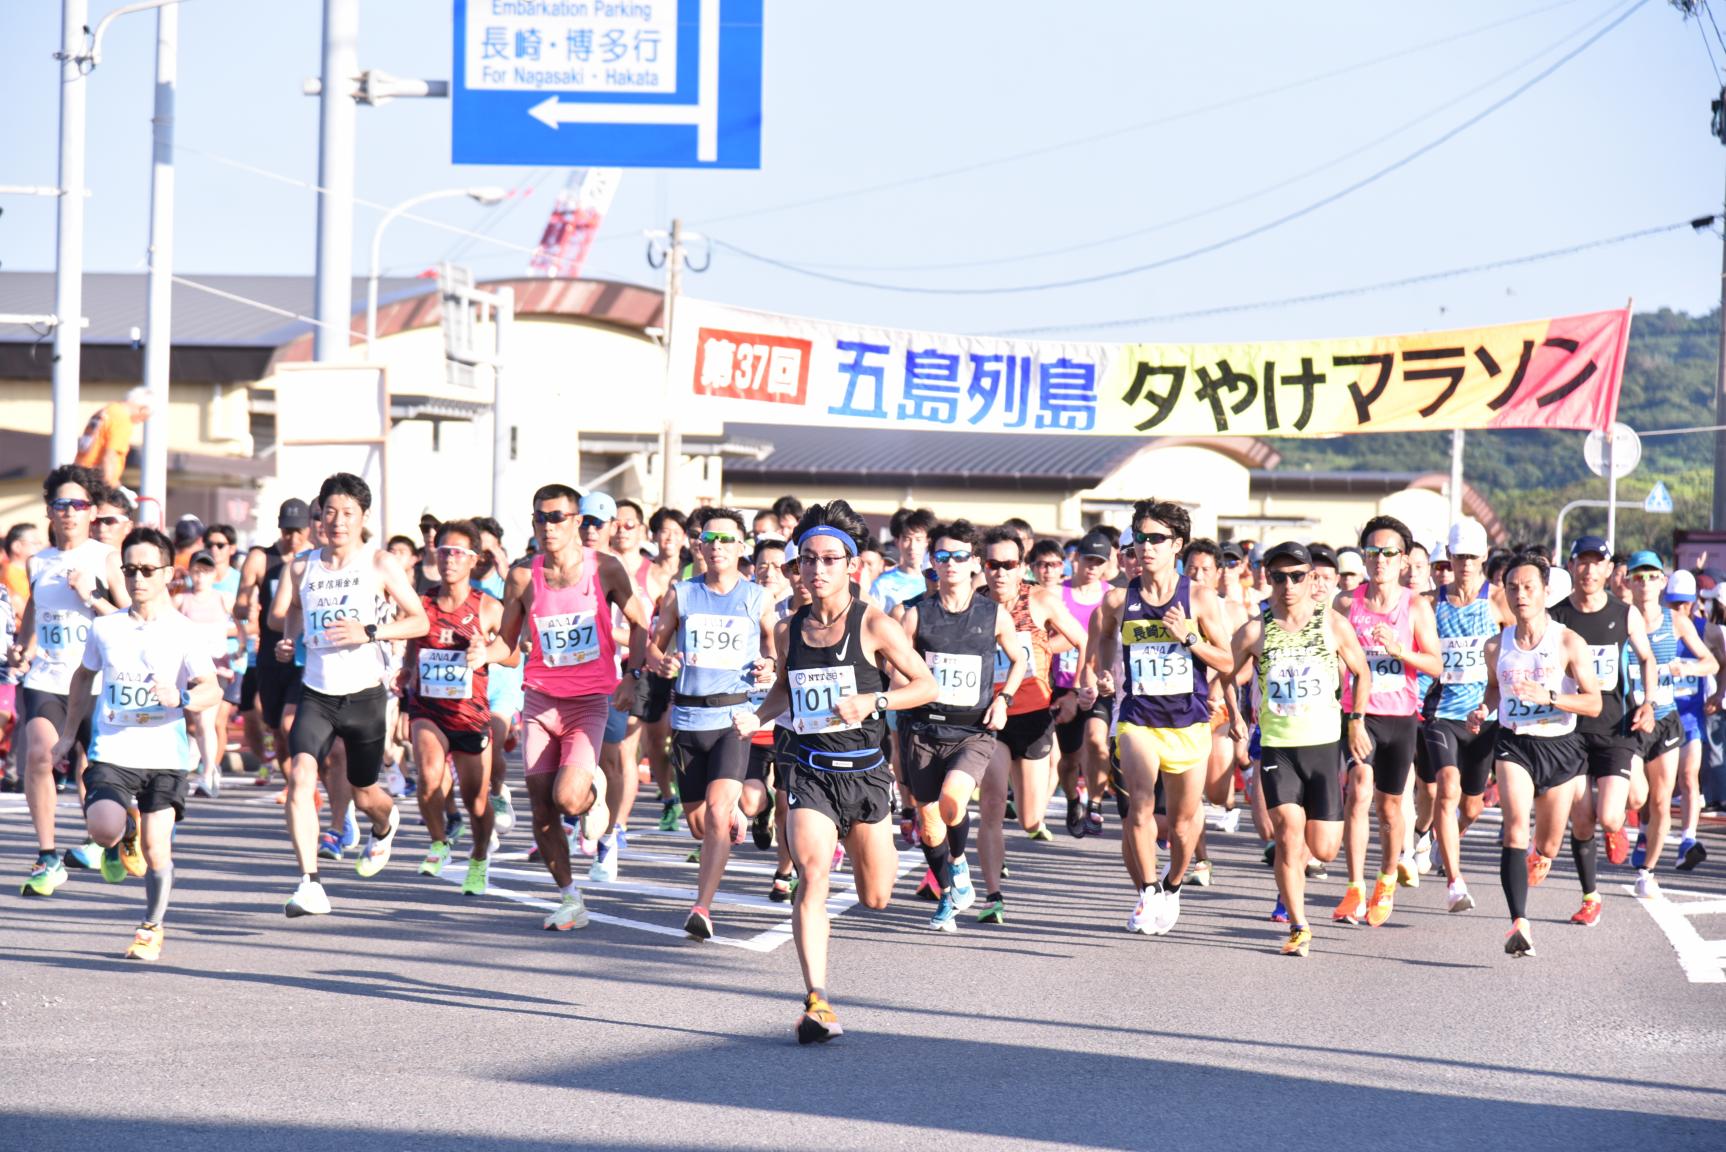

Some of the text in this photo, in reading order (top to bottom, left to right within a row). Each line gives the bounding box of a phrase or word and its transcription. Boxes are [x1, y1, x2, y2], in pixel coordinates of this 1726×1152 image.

[491, 0, 652, 21] Embarkation Parking
[482, 66, 659, 88] For Nagasaki Hakata
[701, 337, 800, 397] 第37回
[42, 624, 88, 645] 1610
[542, 625, 593, 650] 1597
[690, 629, 745, 651] 1596
[1134, 656, 1188, 677] 1153
[1270, 678, 1321, 699] 2153
